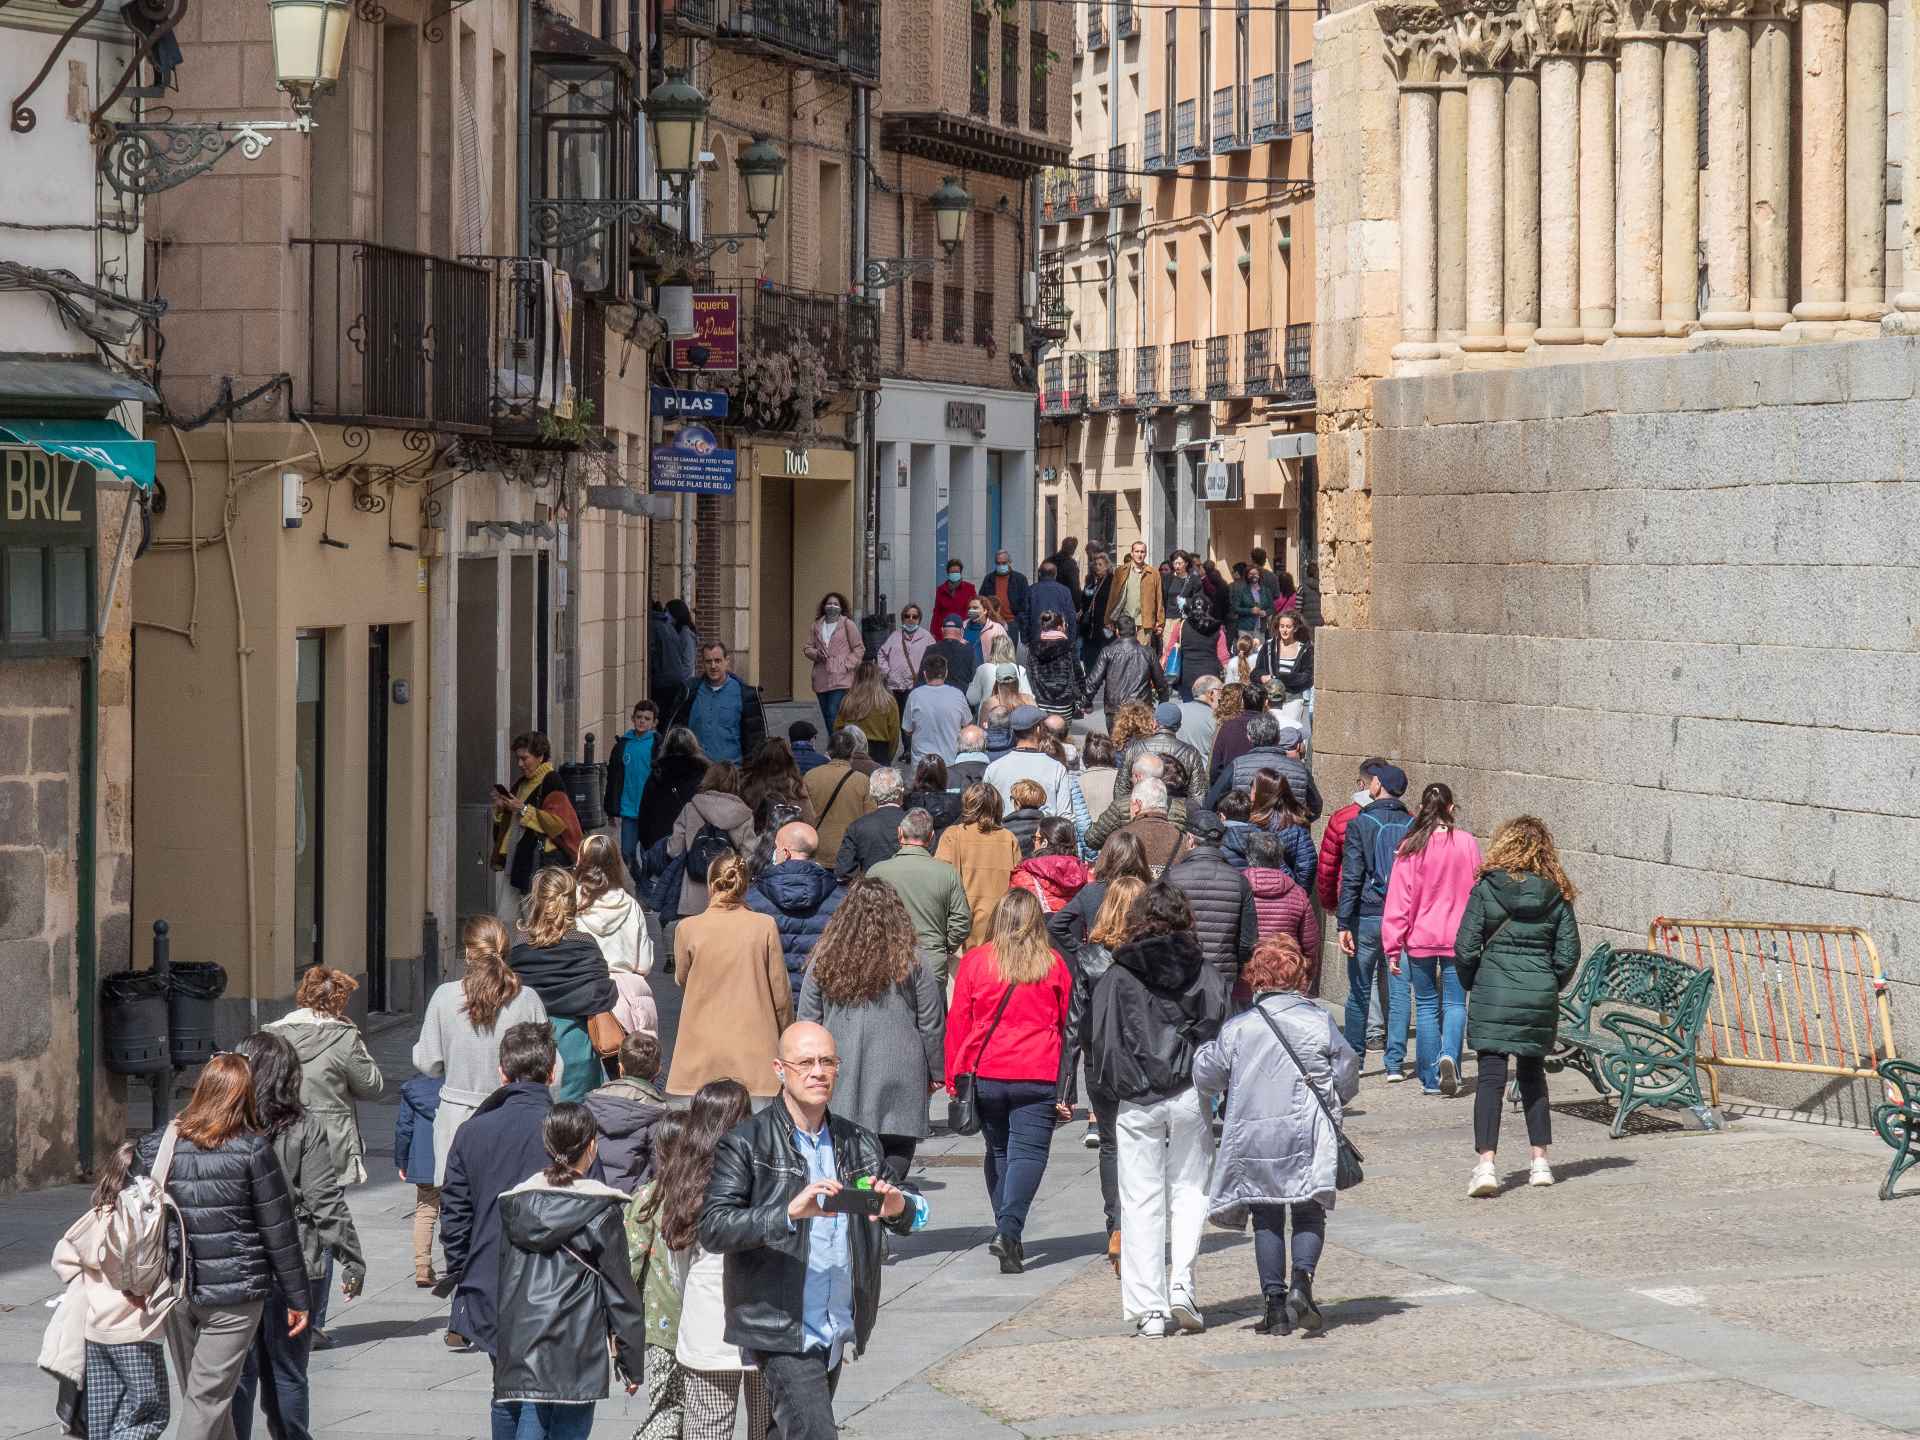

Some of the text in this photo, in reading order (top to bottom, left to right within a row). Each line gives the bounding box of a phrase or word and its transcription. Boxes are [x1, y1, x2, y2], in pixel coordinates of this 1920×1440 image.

[664, 397, 713, 410] PILAS
[785, 449, 808, 474] TOUS
[654, 479, 676, 487] CAMBIO
[703, 481, 711, 489] DE
[712, 482, 731, 490] RELOJ
